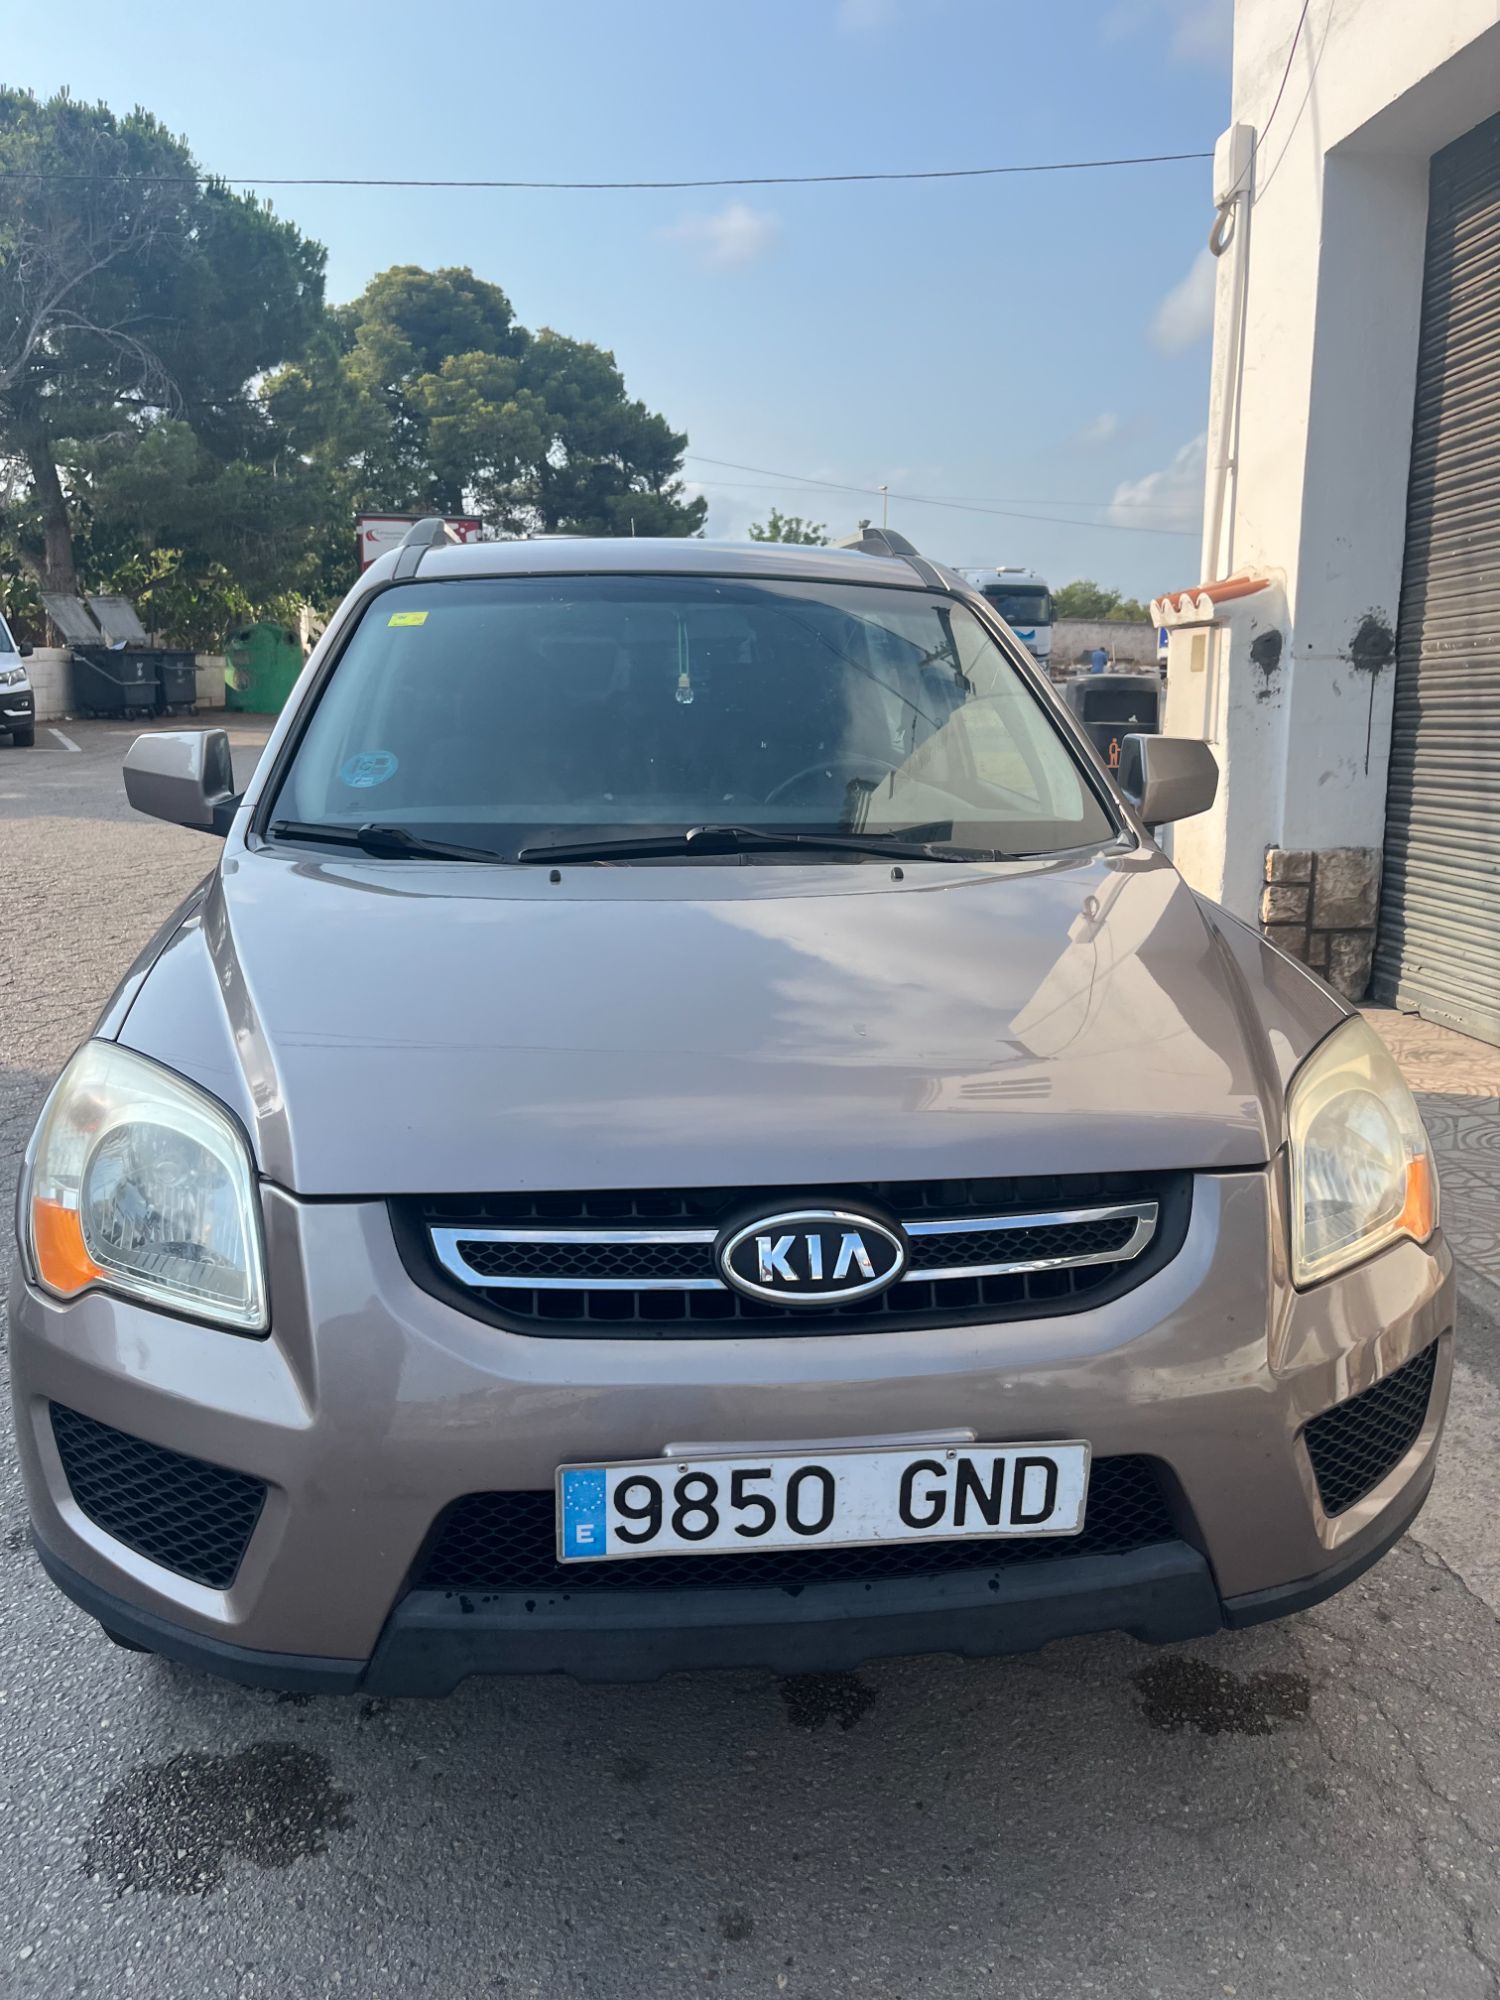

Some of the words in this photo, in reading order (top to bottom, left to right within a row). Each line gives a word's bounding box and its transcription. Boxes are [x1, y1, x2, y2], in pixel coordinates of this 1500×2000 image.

[755, 1232, 876, 1282] KIA
[613, 1465, 836, 1545] 9850
[898, 1455, 1059, 1530] GND
[575, 1523, 595, 1545] E
